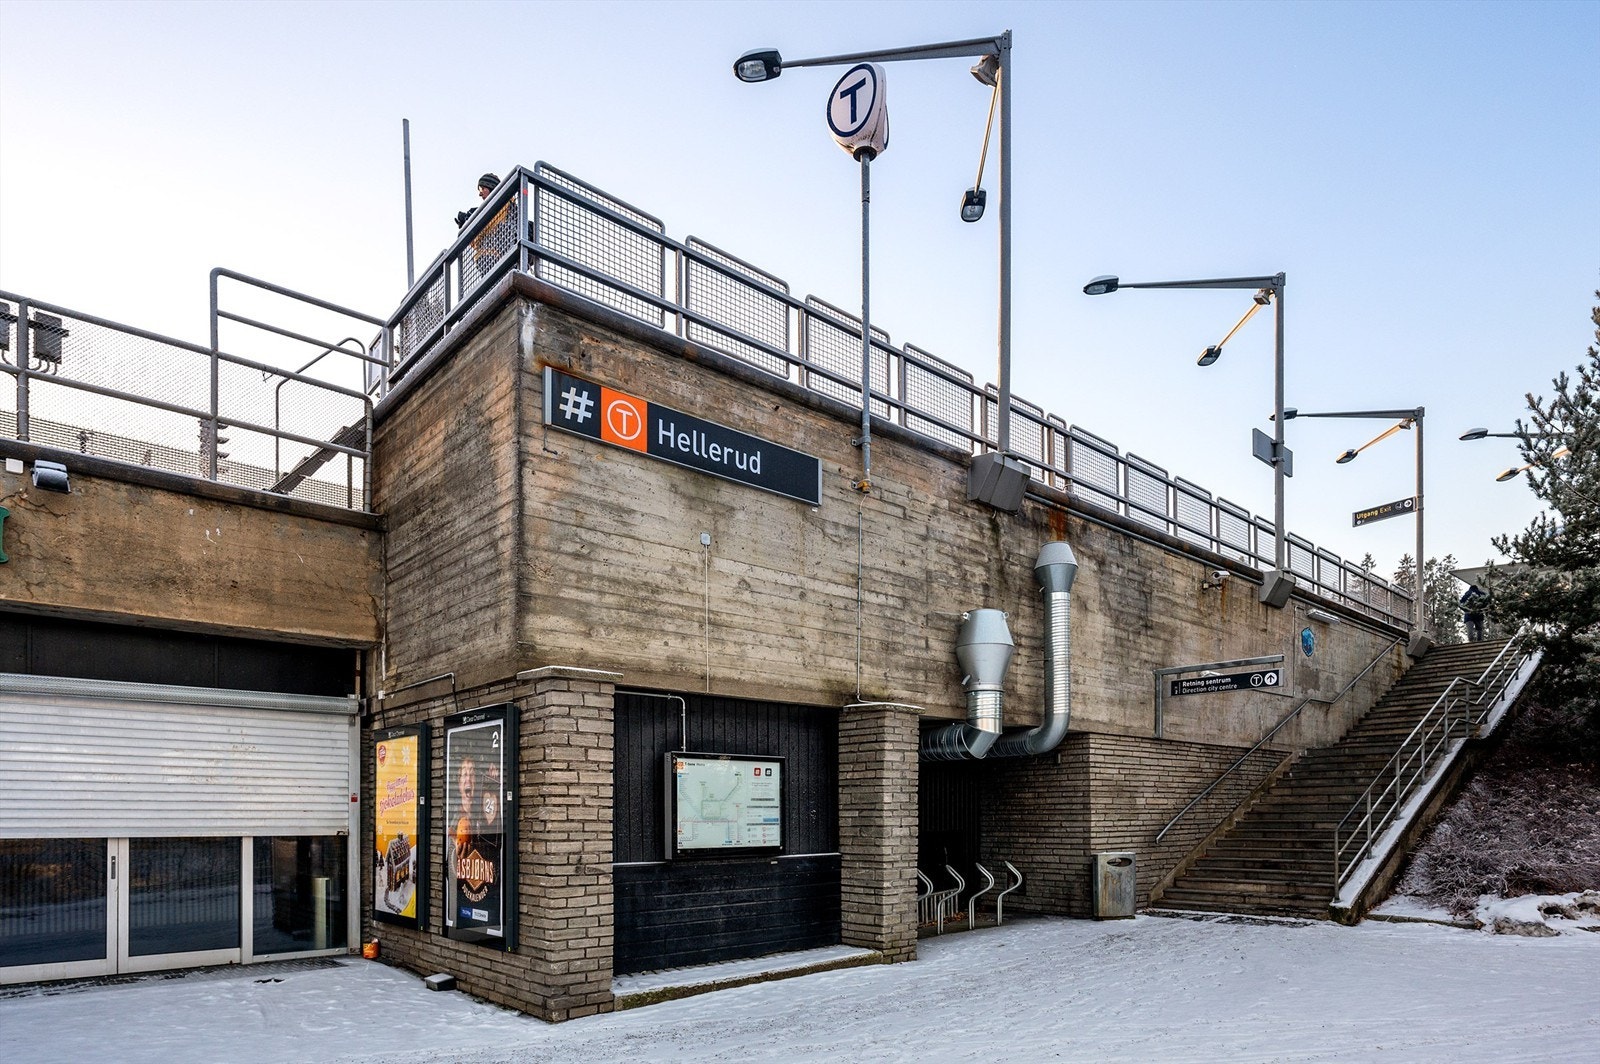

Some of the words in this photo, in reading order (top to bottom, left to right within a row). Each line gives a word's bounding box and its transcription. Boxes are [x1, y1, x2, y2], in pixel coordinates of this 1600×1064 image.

[840, 77, 867, 125] T
[658, 418, 761, 475] Hellerud
[1356, 510, 1378, 519] Utgang
[492, 731, 499, 748] 2
[485, 798, 495, 815] 24
